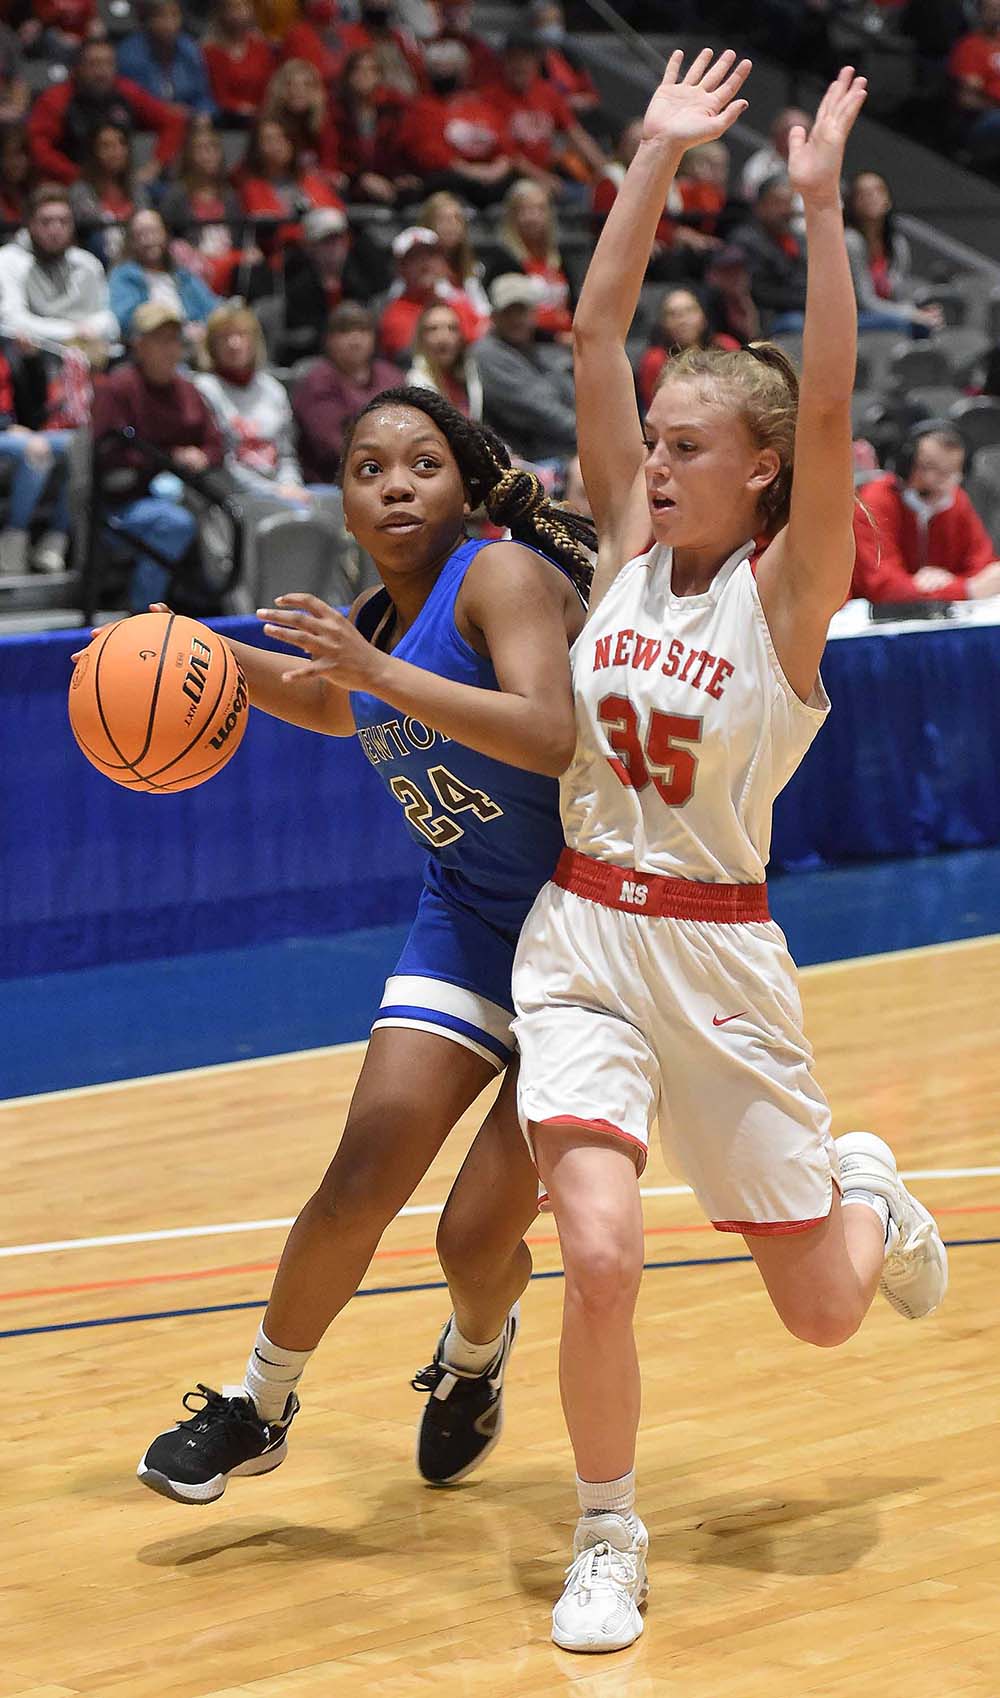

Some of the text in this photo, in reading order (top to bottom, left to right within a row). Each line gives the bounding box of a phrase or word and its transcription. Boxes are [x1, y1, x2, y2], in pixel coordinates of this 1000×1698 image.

[182, 638, 213, 706] EVO
[592, 629, 736, 700] NEW SITE
[184, 703, 198, 729] NXT
[358, 715, 452, 766] EWTO
[597, 692, 704, 808] 35
[389, 764, 504, 848] 24
[619, 880, 649, 906] NS
